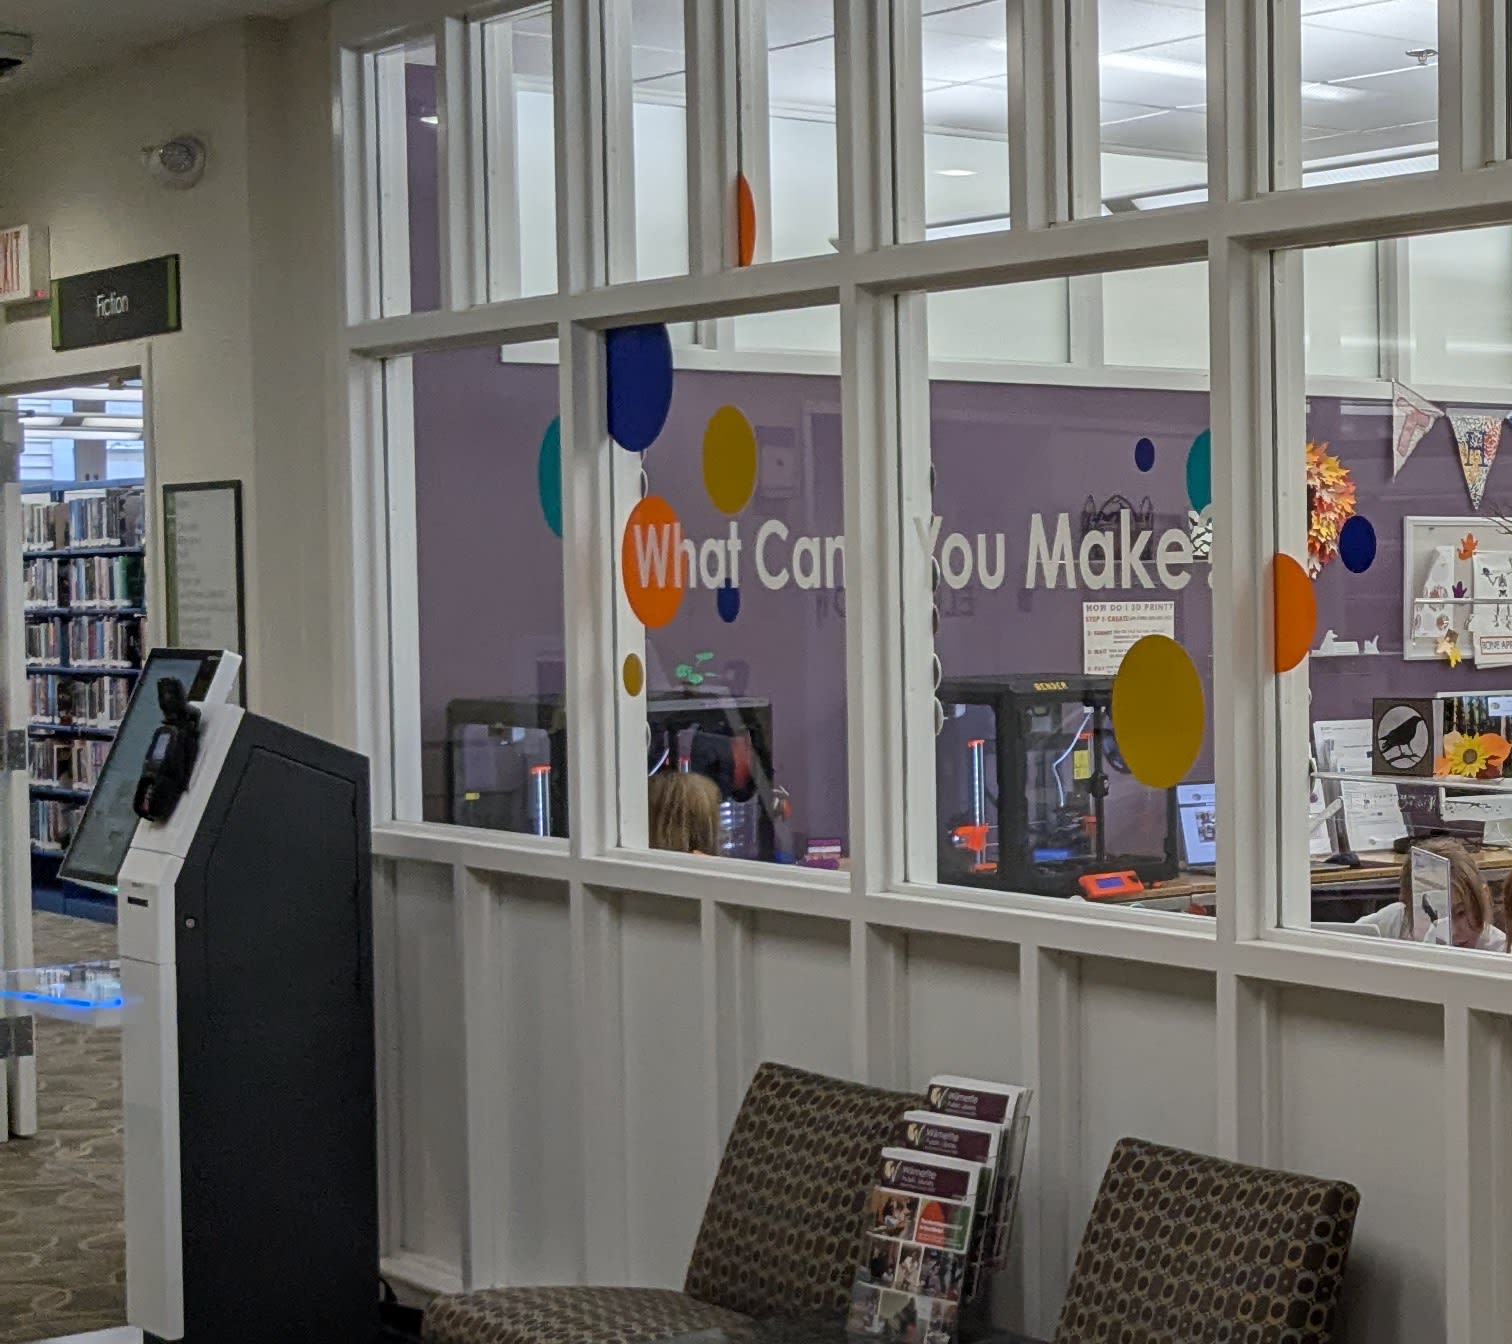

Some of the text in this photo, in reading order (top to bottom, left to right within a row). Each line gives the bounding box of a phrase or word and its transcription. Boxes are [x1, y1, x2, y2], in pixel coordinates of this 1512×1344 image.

[0, 231, 20, 293] XIT
[96, 292, 129, 318] Fiction
[633, 521, 741, 589] What
[755, 519, 846, 590] Can
[913, 516, 1005, 590] You
[1144, 603, 1173, 611] PRINT?
